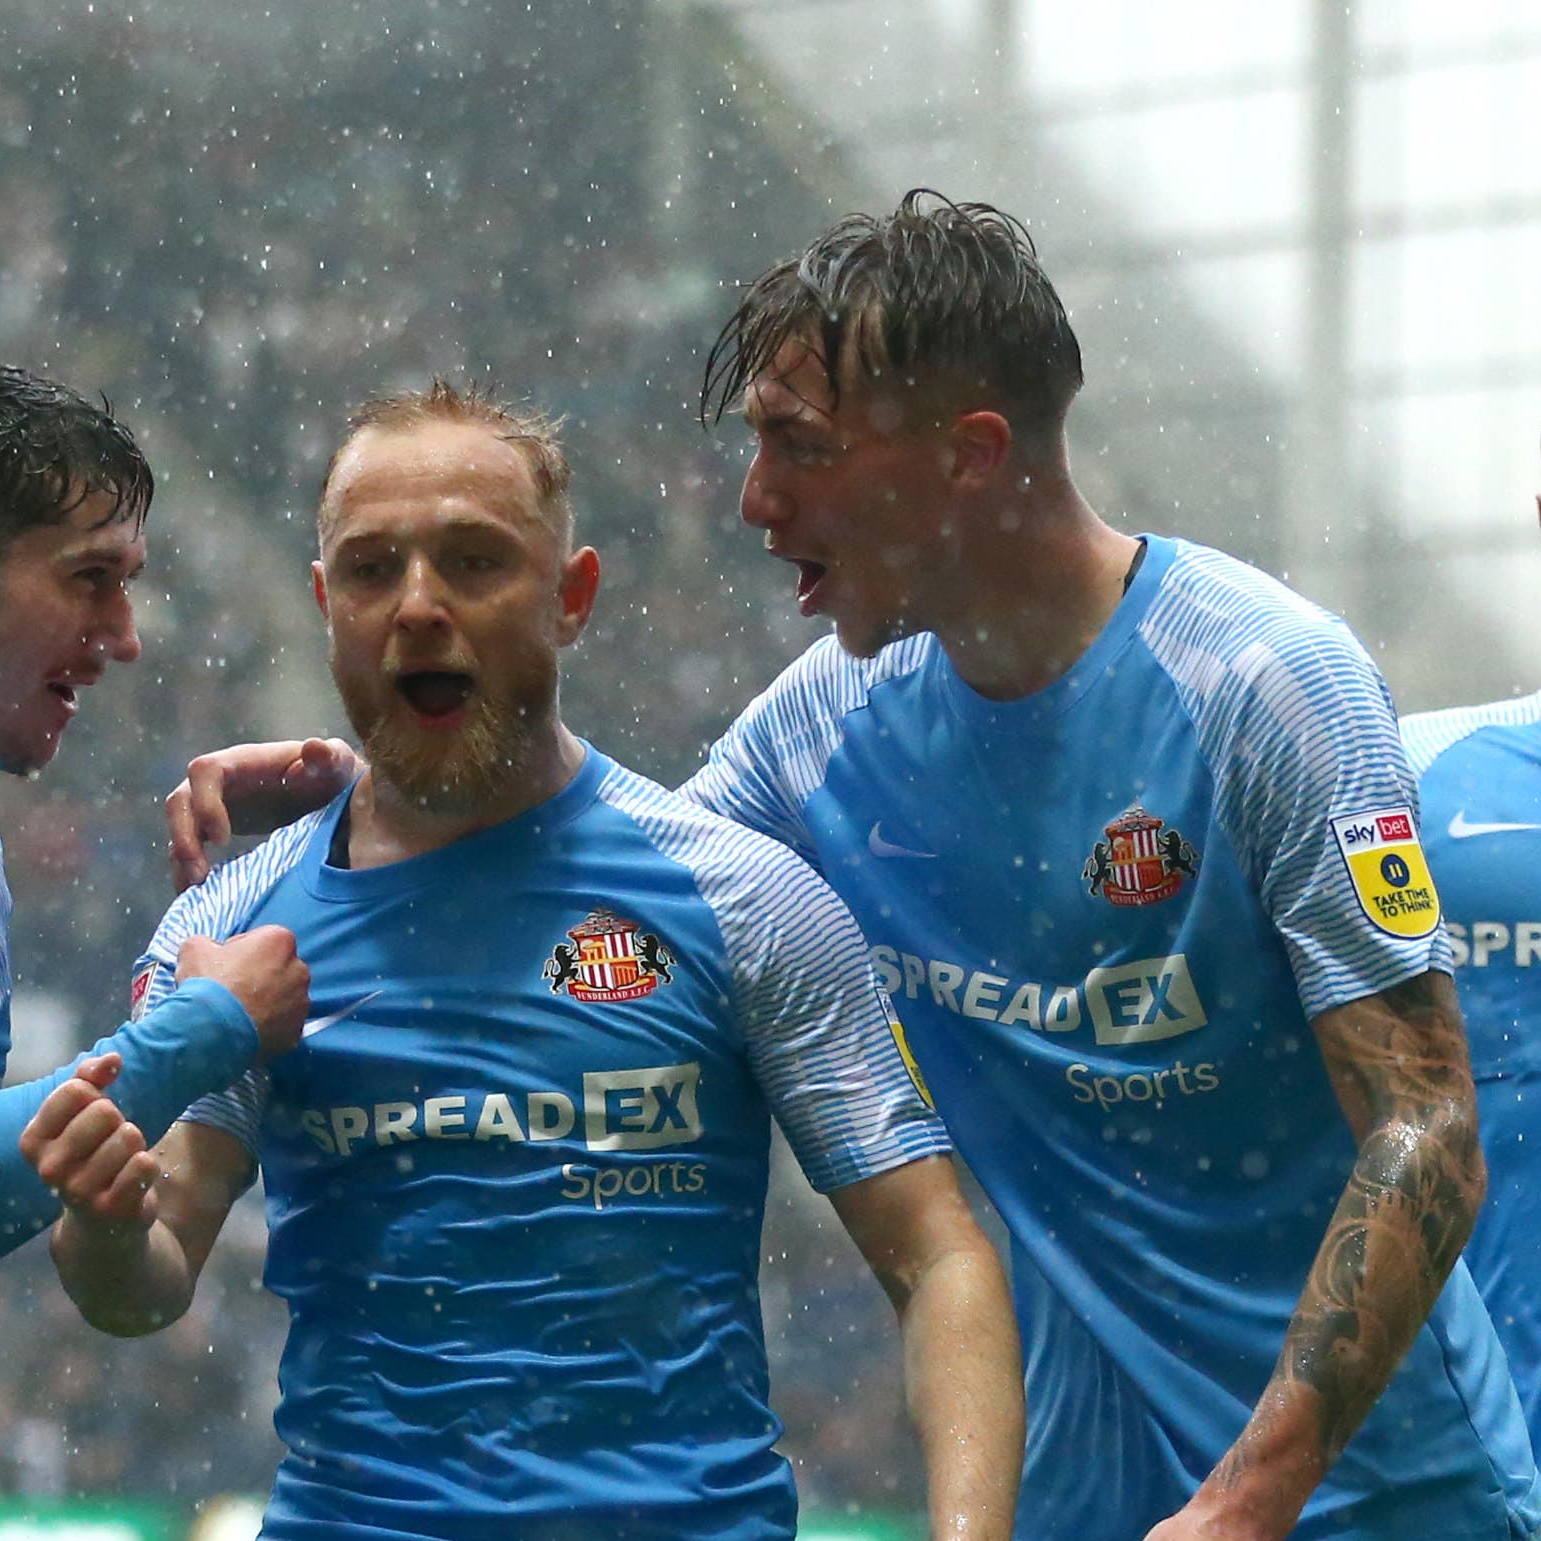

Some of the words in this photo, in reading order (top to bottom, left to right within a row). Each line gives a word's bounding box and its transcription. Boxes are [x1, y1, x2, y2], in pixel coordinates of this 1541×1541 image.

[1344, 824, 1375, 844] sky
[1379, 819, 1409, 836] bet
[1373, 891, 1404, 907] TAKE
[1405, 888, 1429, 899] TIME
[1380, 905, 1398, 918] TO
[1399, 900, 1434, 914] THINK
[1065, 1060, 1221, 1113] Sports
[561, 1160, 707, 1210] Sports
